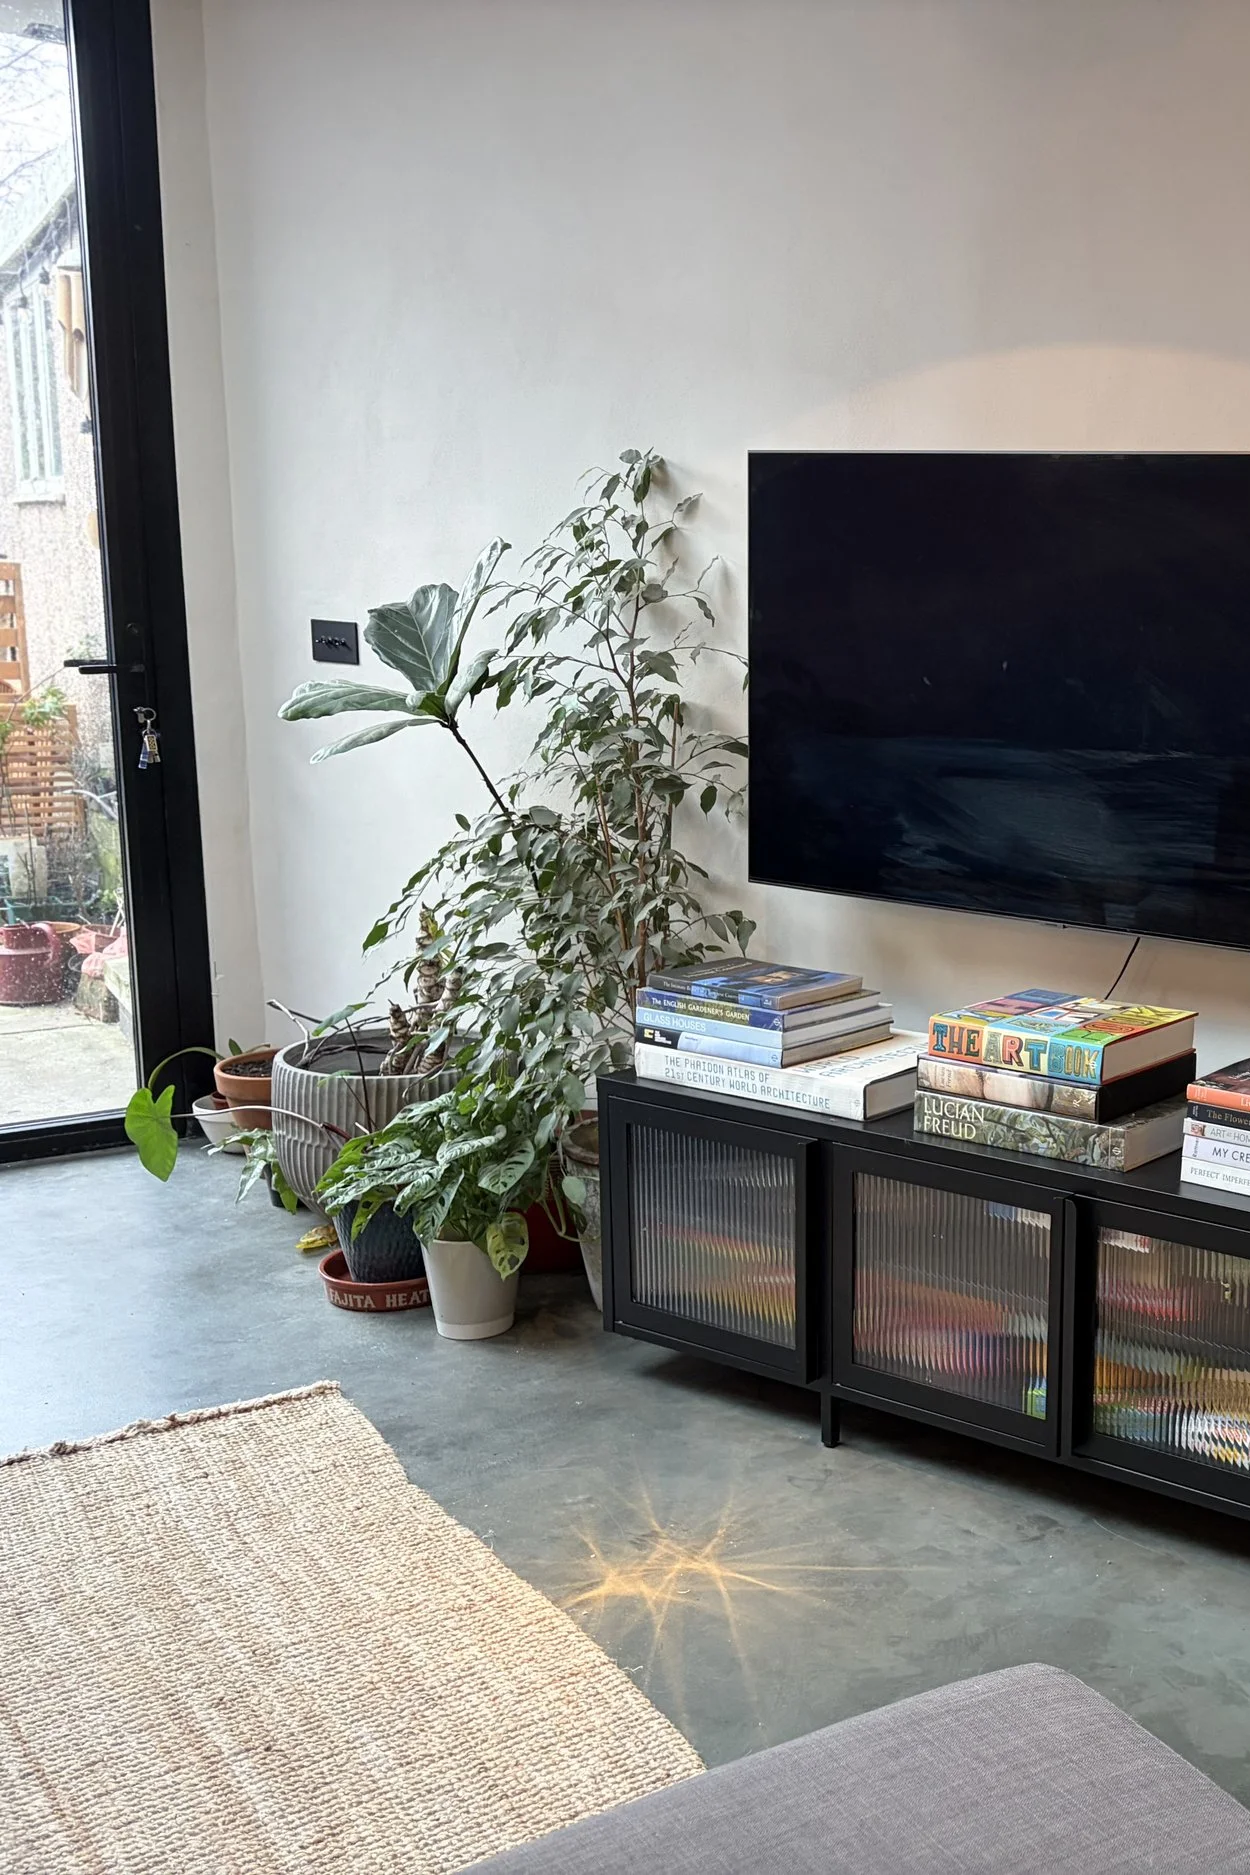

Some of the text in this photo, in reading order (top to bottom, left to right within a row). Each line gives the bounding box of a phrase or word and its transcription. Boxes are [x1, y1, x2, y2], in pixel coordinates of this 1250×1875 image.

[663, 999, 687, 1011] ENGLISH
[688, 1003, 724, 1016] GARDENER'S
[725, 1009, 750, 1021] GARDEN
[643, 1012, 706, 1032] GLASS HOUSES
[932, 1022, 1100, 1079] THE ART BOOK
[664, 1055, 770, 1083] THE PHAIDON ATLAS OF
[687, 1071, 726, 1088] CENTURY
[729, 1080, 758, 1095] WORLD
[760, 1085, 831, 1109] ARCHITECTURE
[924, 1097, 985, 1123] LUCIAN
[1206, 1109, 1222, 1120] The
[923, 1116, 977, 1139] FREUD
[1211, 1128, 1226, 1138] ART
[1212, 1146, 1229, 1159] MY
[1190, 1166, 1221, 1181] PERFECT
[329, 1288, 376, 1308] FAJITA
